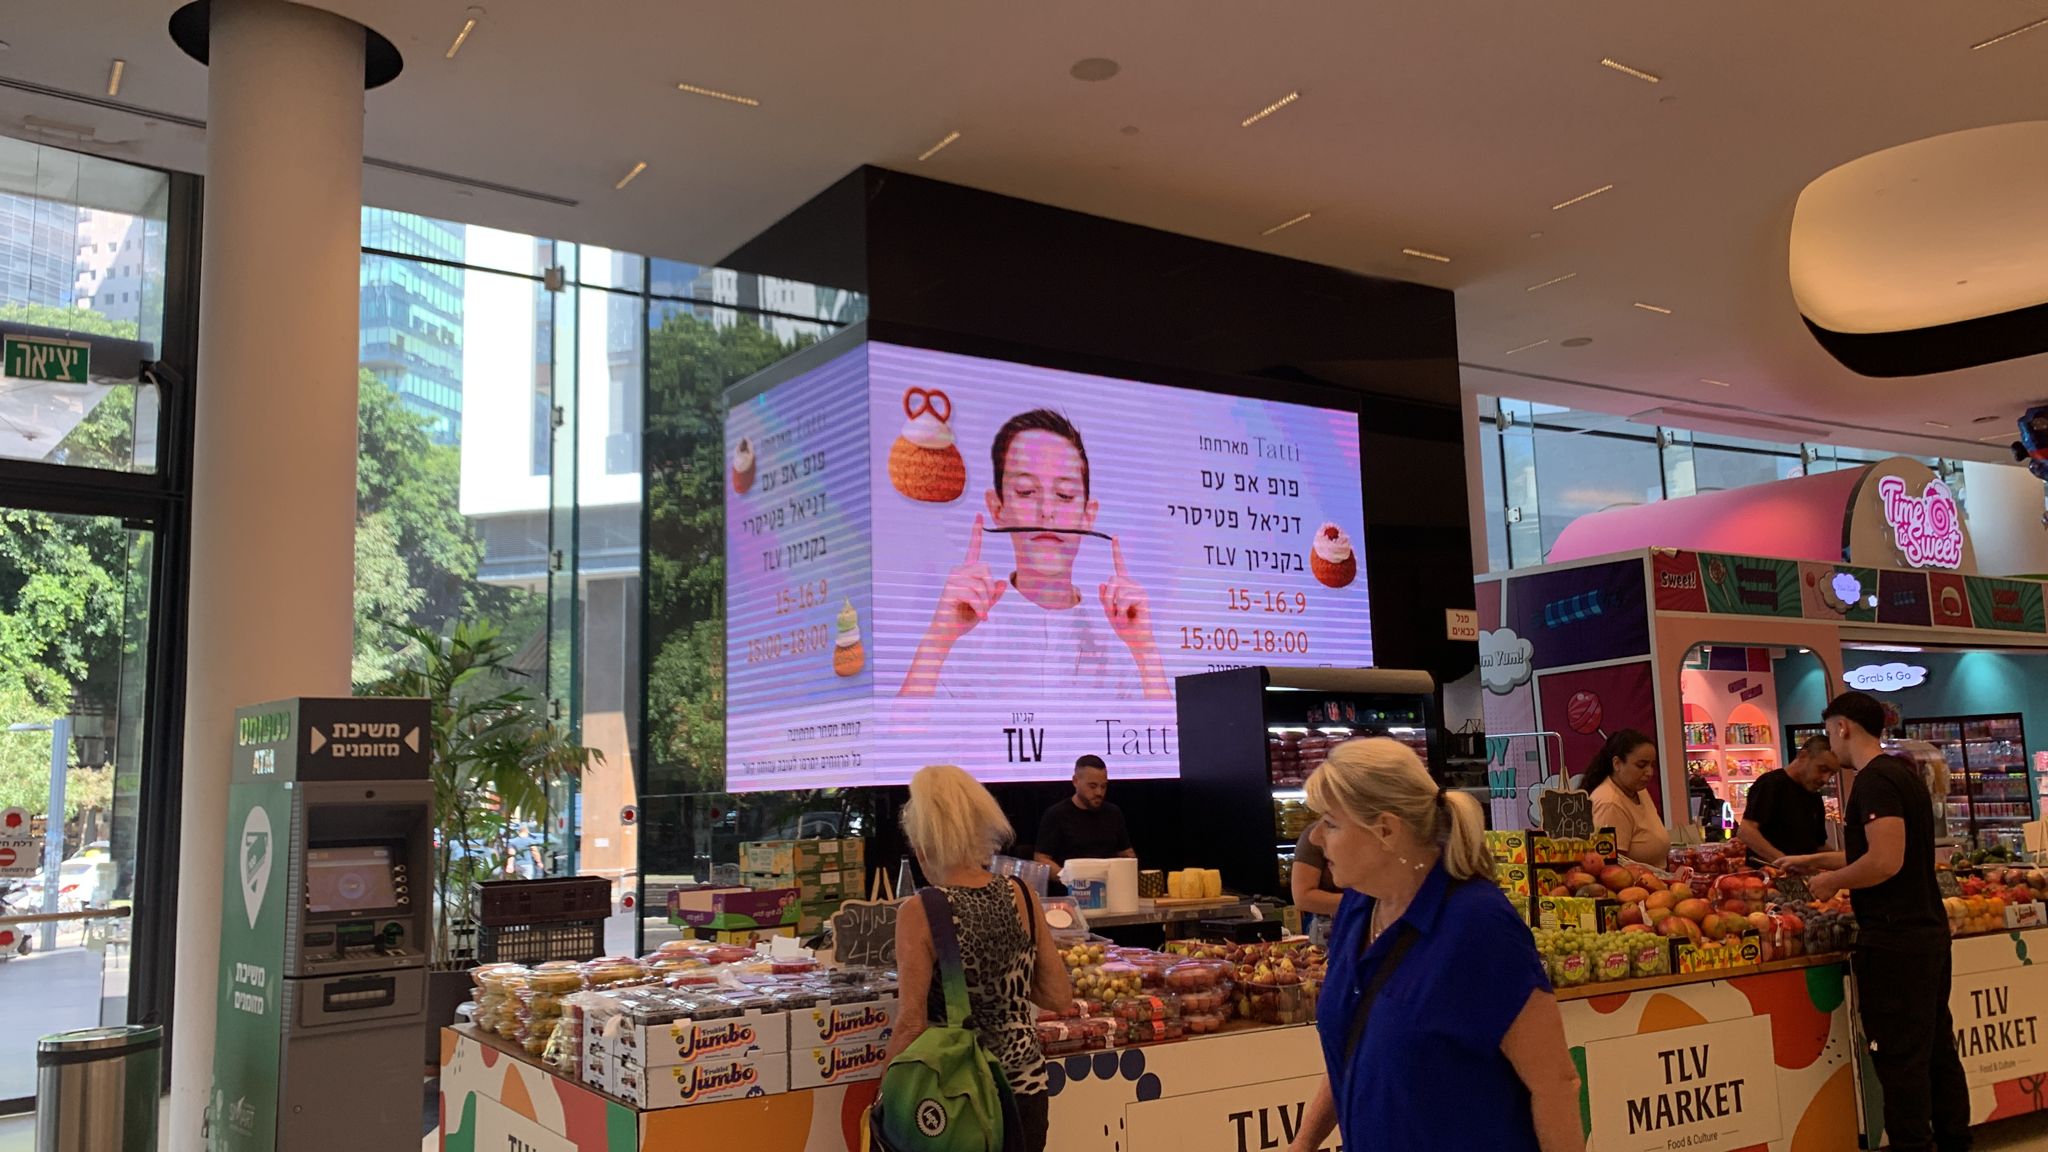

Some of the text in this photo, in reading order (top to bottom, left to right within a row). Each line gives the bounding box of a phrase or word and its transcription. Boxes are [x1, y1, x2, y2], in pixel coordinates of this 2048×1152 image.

[16, 343, 78, 380] יציאה
[1199, 434, 1300, 462] Tatti מארחת!
[762, 451, 826, 493] פופ אפ עם
[1200, 469, 1299, 498] פופ אפ עם
[789, 493, 826, 524] דניאל
[1881, 479, 1925, 524] Time
[1167, 504, 1301, 534] דניאל פטיסרי
[1898, 523, 1909, 547] to
[1907, 527, 1961, 565] Sweet
[762, 535, 827, 572] בקניון TLV
[1203, 545, 1304, 574] בקניון TLV
[1660, 570, 1697, 590] Sweet!
[775, 578, 828, 615] 15-16.9
[1227, 588, 1306, 614] 15-16.9
[747, 623, 829, 663] 15:00-18:00
[1180, 626, 1308, 654] 15:00-18:00
[1496, 647, 1525, 666] Yum!
[1857, 671, 1912, 684] Grab & Go
[332, 722, 400, 739] משיכת
[1011, 711, 1035, 725] קניון
[332, 743, 400, 758] מזומנים
[1002, 727, 1044, 763] TLV
[1095, 719, 1173, 756] Tatt
[252, 748, 275, 775] ATM
[235, 962, 266, 988] משיכת
[234, 990, 265, 1016] מזומנים
[1970, 986, 2009, 1019] TLV
[820, 1006, 888, 1042] Jumbo
[678, 1023, 754, 1060] Jumbo
[821, 1043, 888, 1080] Jumbo
[1658, 1044, 1709, 1085] TLV
[680, 1063, 756, 1100] Jumbo
[1626, 1079, 1745, 1135] MARKET
[1228, 1101, 1306, 1152] TLV
[1667, 1131, 1718, 1151] Food & Culture
